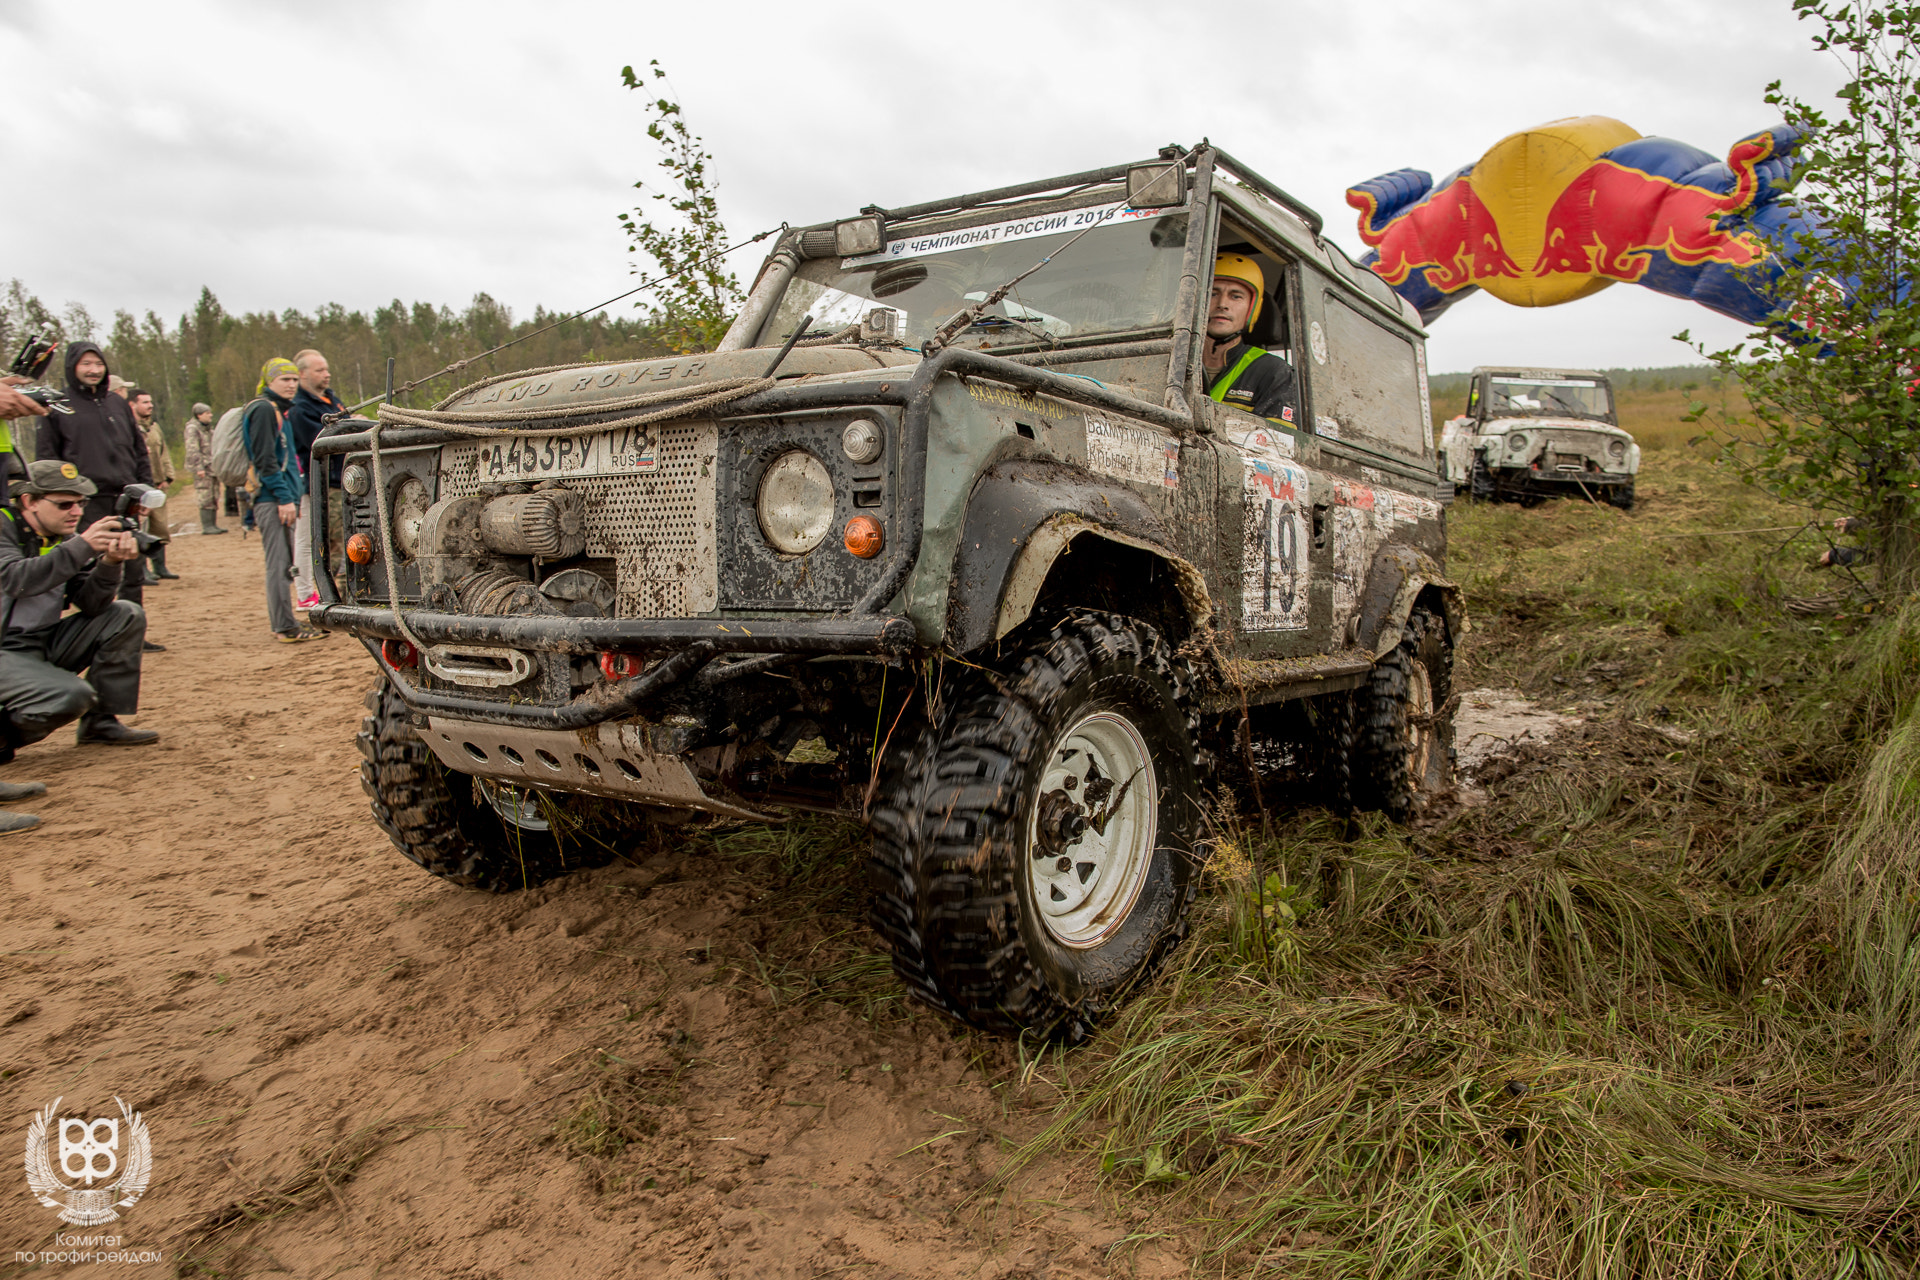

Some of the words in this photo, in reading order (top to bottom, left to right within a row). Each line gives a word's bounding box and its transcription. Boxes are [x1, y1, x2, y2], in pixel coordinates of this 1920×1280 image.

[910, 228, 1001, 253] ЧЕМПИОНАТ
[1004, 216, 1067, 237] РОССИИ
[462, 381, 554, 406] LAND
[570, 360, 707, 392] ROVER
[611, 454, 635, 468] RUS
[1257, 498, 1297, 613] 19
